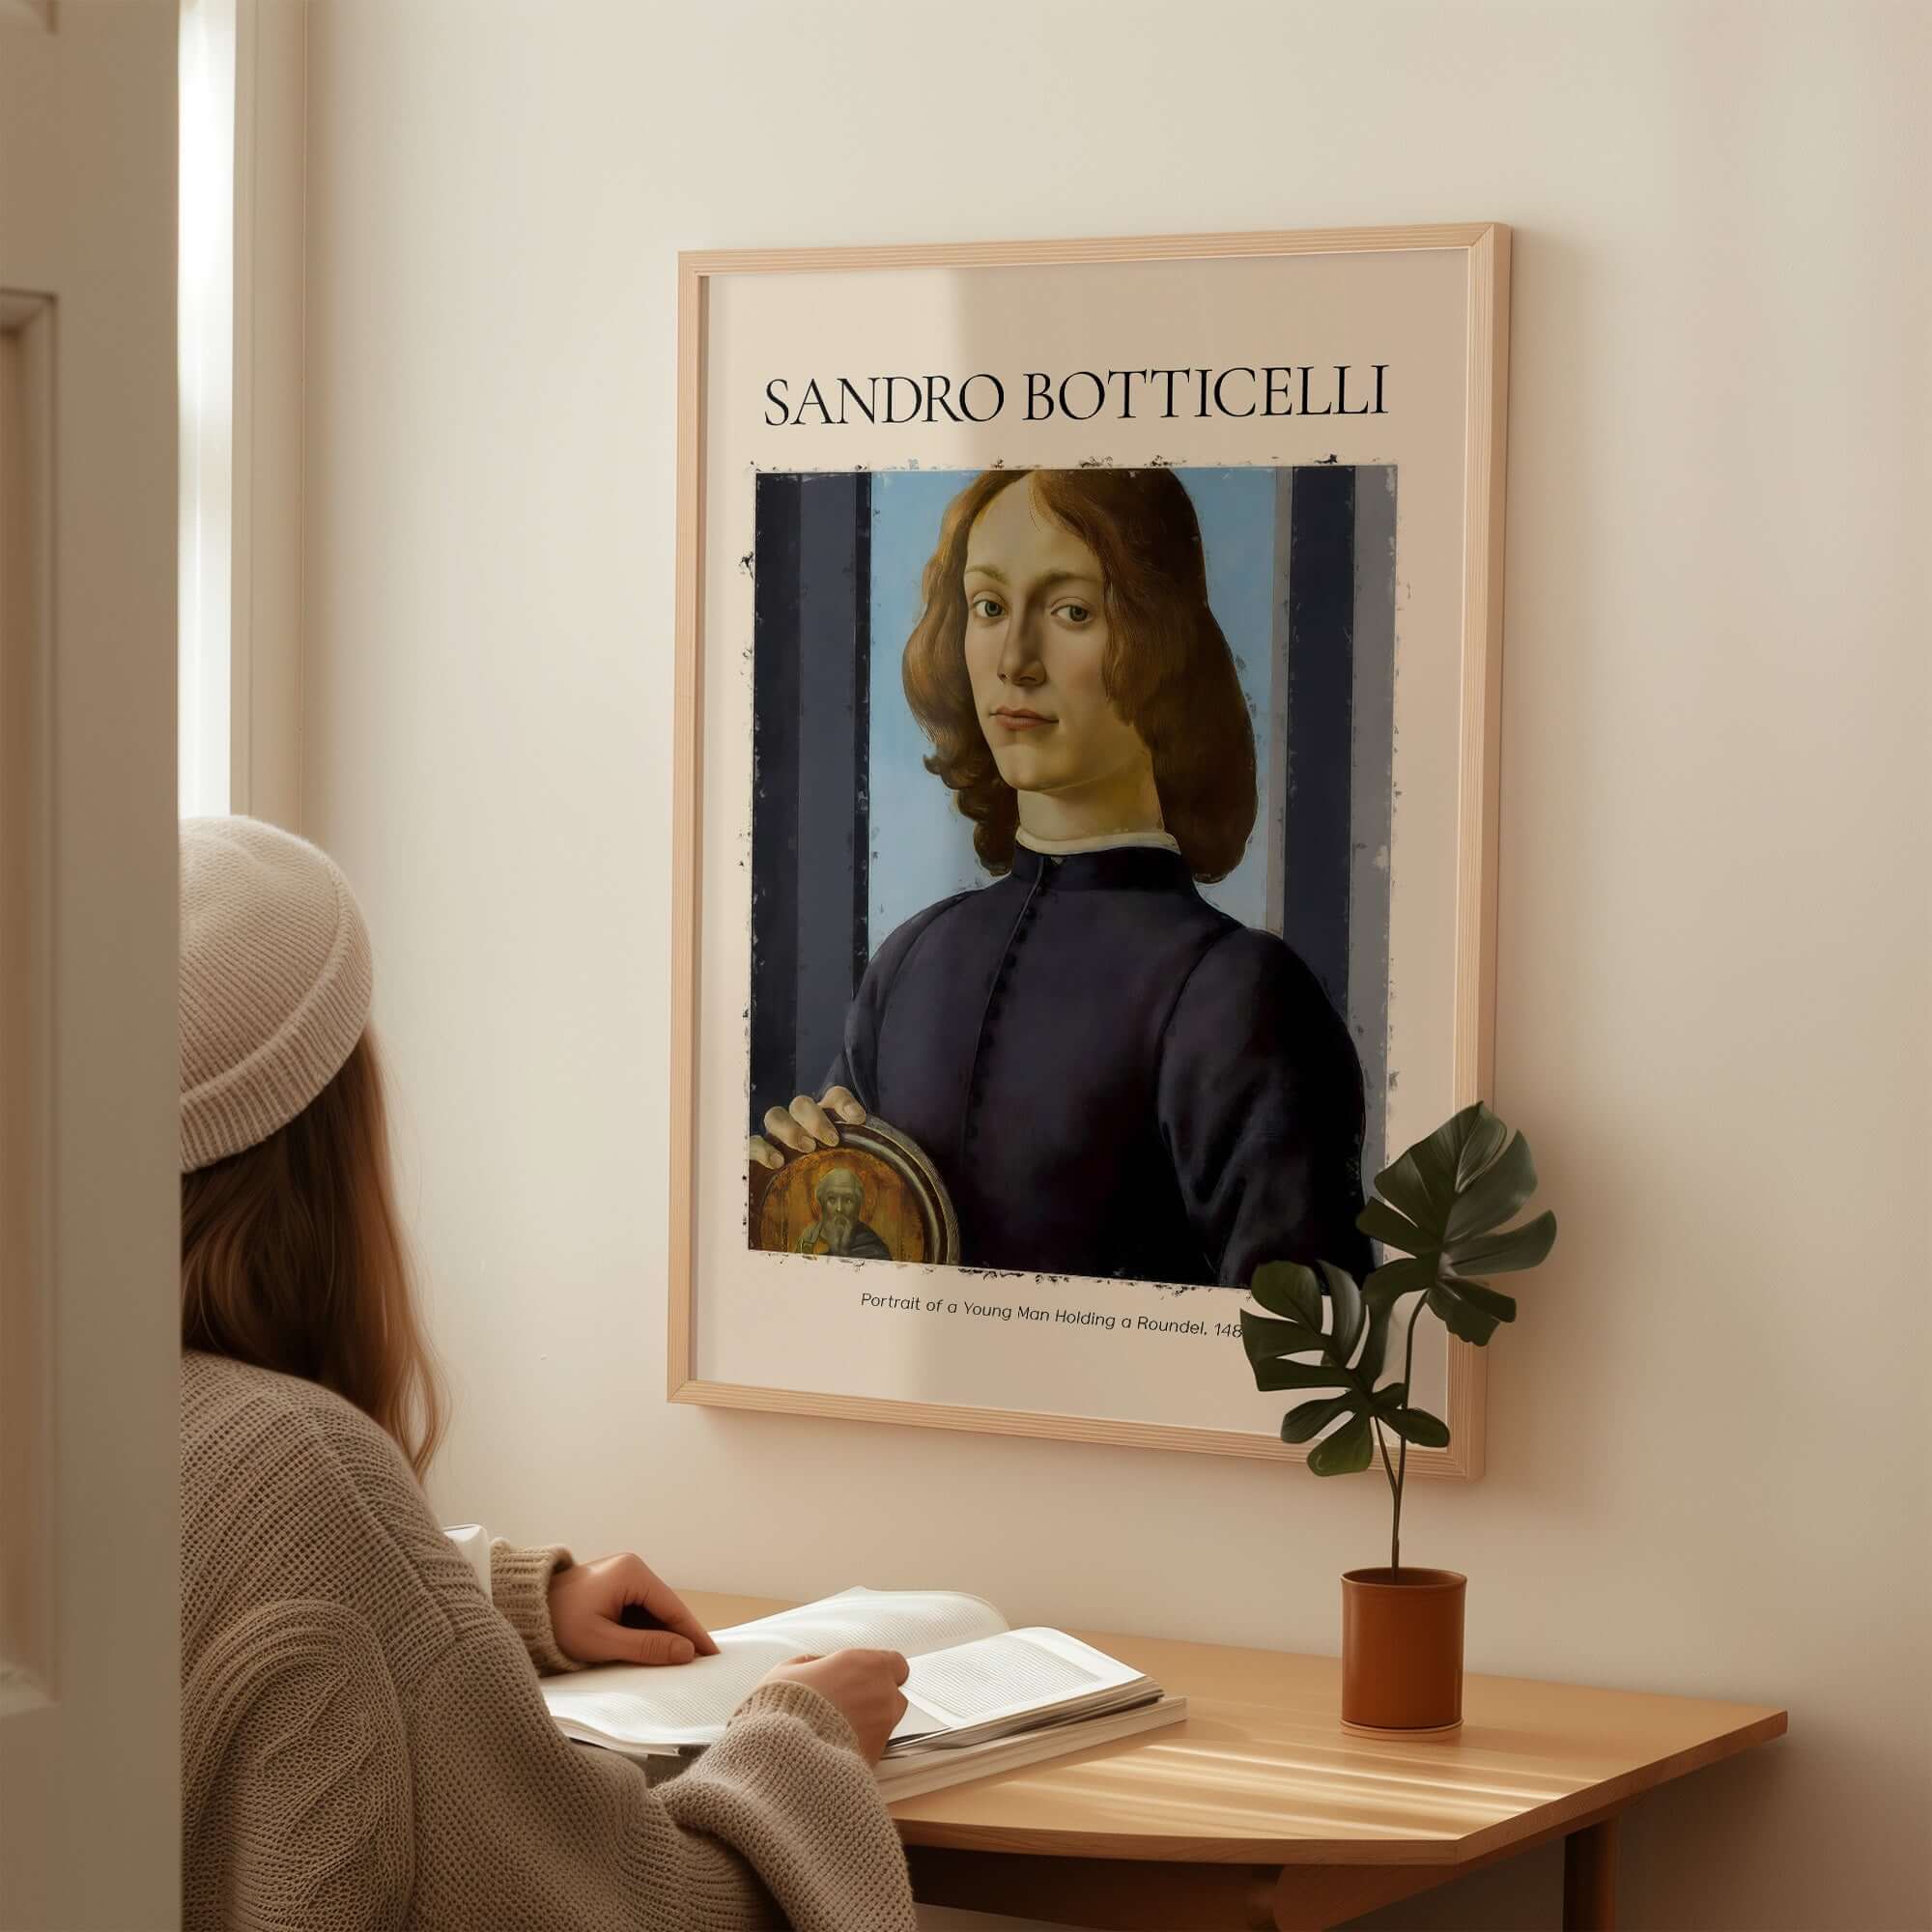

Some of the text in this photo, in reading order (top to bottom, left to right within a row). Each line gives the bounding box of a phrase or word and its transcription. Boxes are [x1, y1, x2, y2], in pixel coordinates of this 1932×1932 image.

[764, 363, 1391, 427] SANDRO BOTTICELLI
[860, 1292, 922, 1312] Portrait
[924, 1298, 945, 1314] of
[946, 1301, 958, 1315] a
[963, 1300, 1013, 1322] Young
[1016, 1305, 1050, 1322] Man
[1054, 1308, 1117, 1331] Holding
[1120, 1316, 1132, 1329] a
[1213, 1321, 1243, 1340] 148
